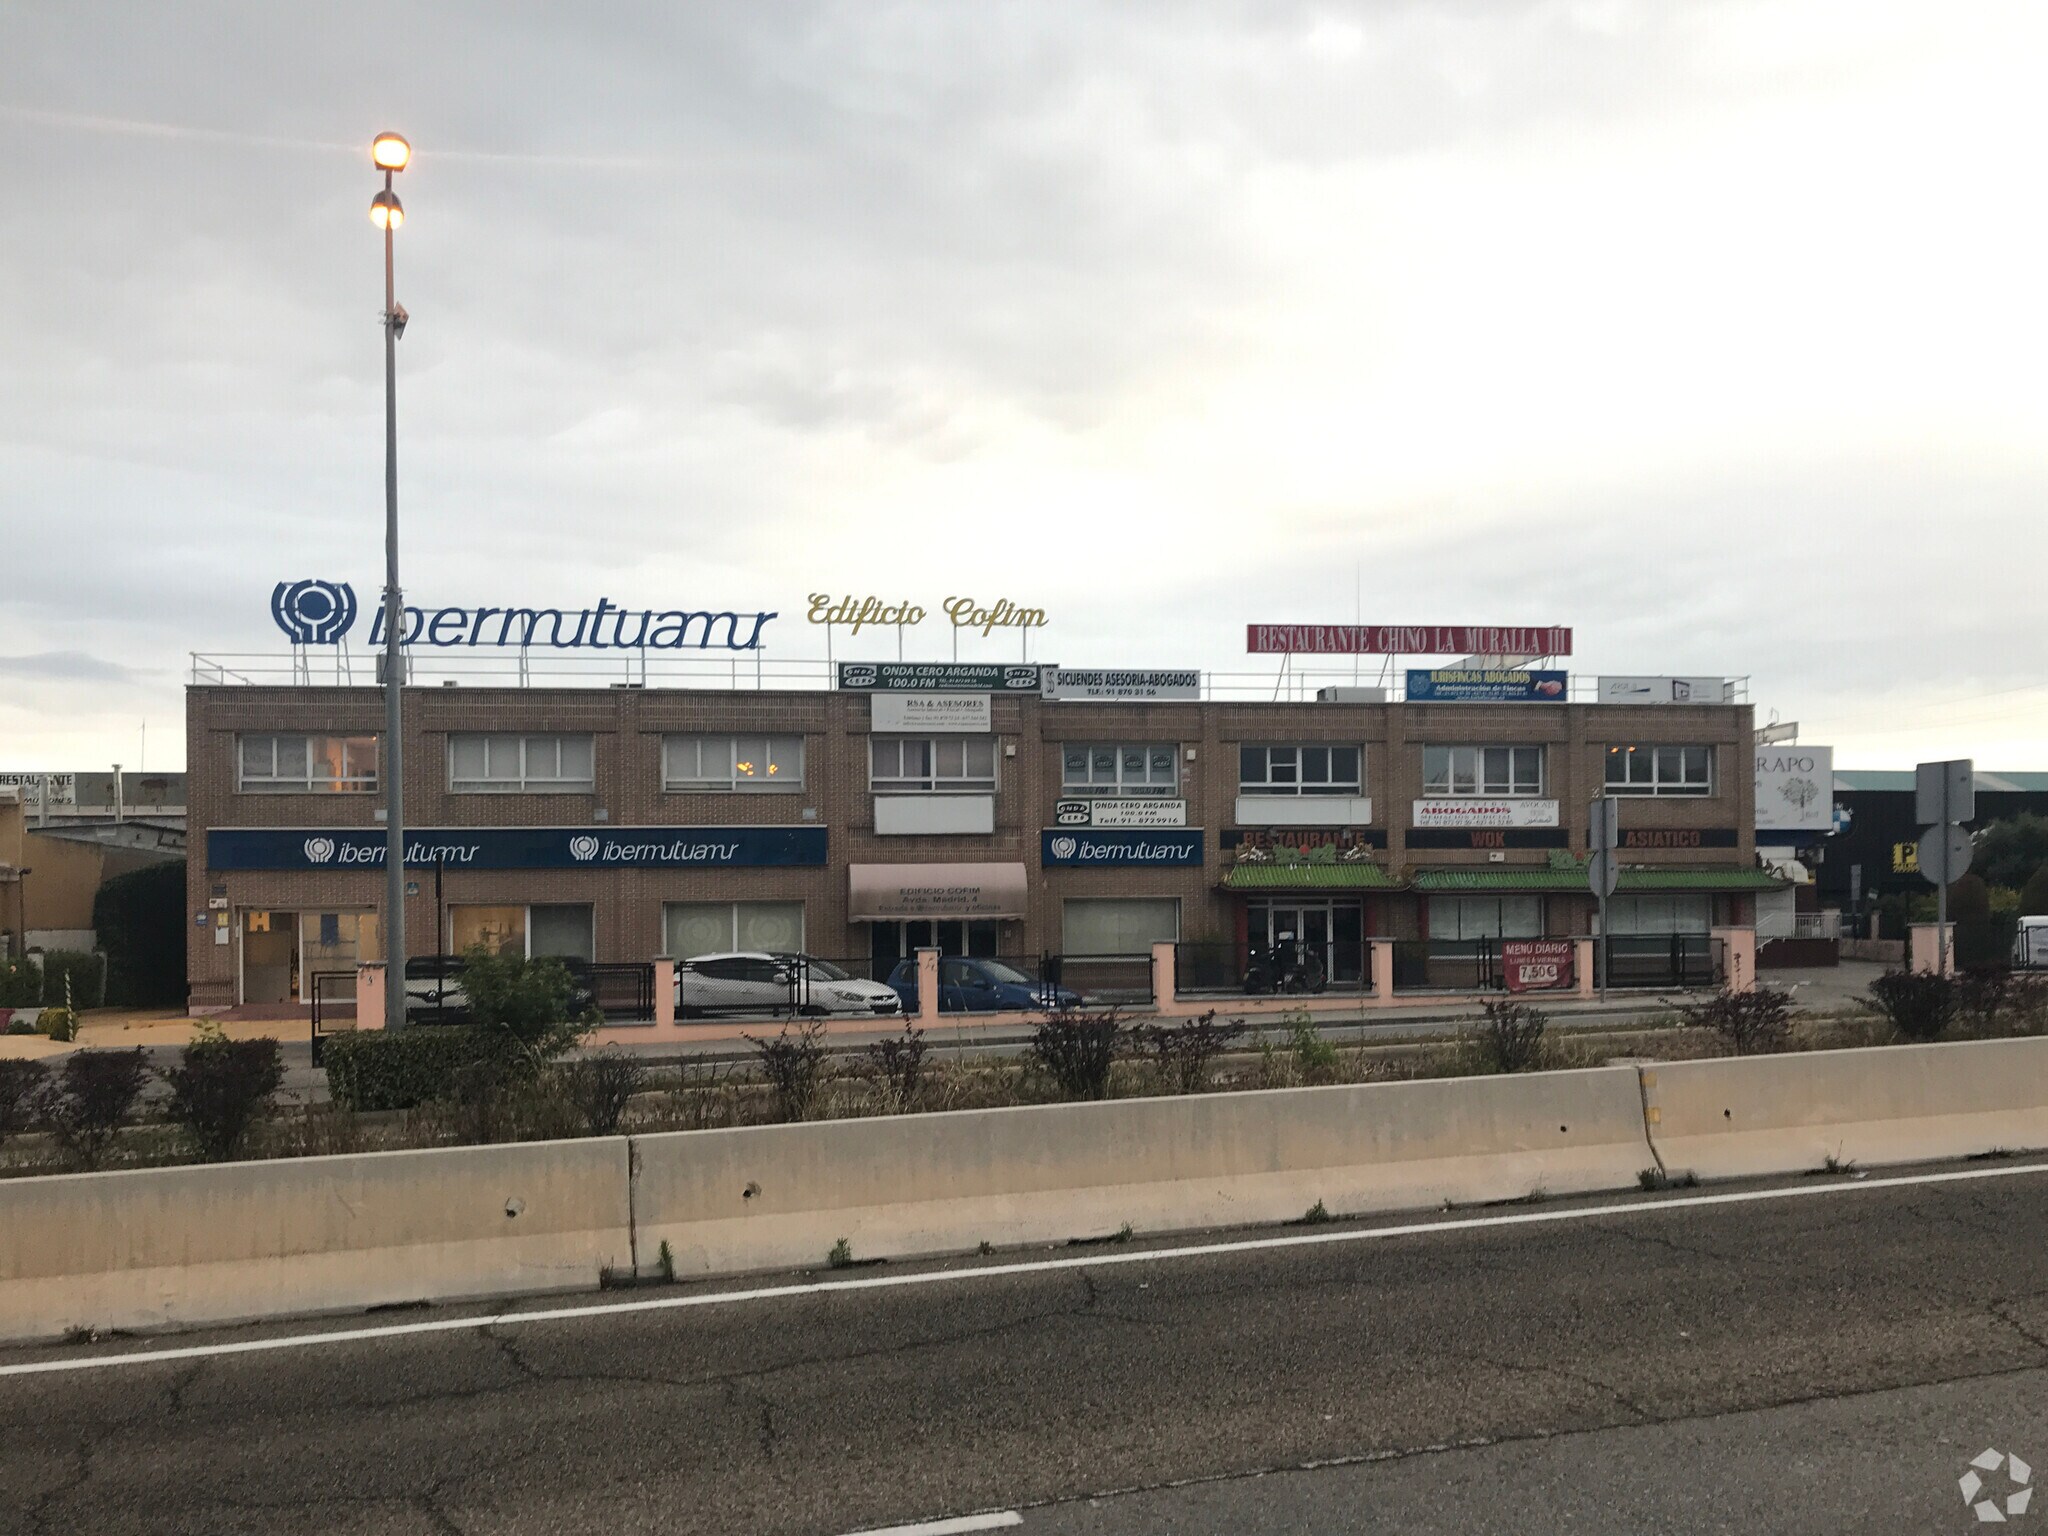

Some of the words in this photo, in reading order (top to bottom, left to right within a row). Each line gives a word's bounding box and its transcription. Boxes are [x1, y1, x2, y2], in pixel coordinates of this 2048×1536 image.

[808, 592, 927, 636] Edificio
[943, 596, 1049, 637] Cofim
[1256, 626, 1370, 651] RESTAURANTE
[1378, 627, 1427, 652] CHINO
[1434, 628, 1456, 652] LA
[1465, 628, 1541, 654] MURALLA
[1549, 628, 1567, 653] III
[882, 666, 914, 676] ONDA
[916, 666, 944, 676] CERO
[945, 666, 999, 677] ARGANDA
[1484, 671, 1530, 684] ABOGADOS
[887, 678, 917, 688] 100.0
[917, 678, 936, 688] FM
[1057, 672, 1103, 686] SICUENDES
[936, 700, 984, 708] ASESORES
[0, 774, 72, 786] RESTAUNTE
[1421, 807, 1512, 815] ABOGADOS
[1471, 831, 1505, 848] WOK
[1626, 831, 1701, 848] ASIATICO
[1506, 942, 1533, 955] MENÚ
[1535, 943, 1568, 954] DIARIO
[1520, 965, 1556, 980] 7,50€
